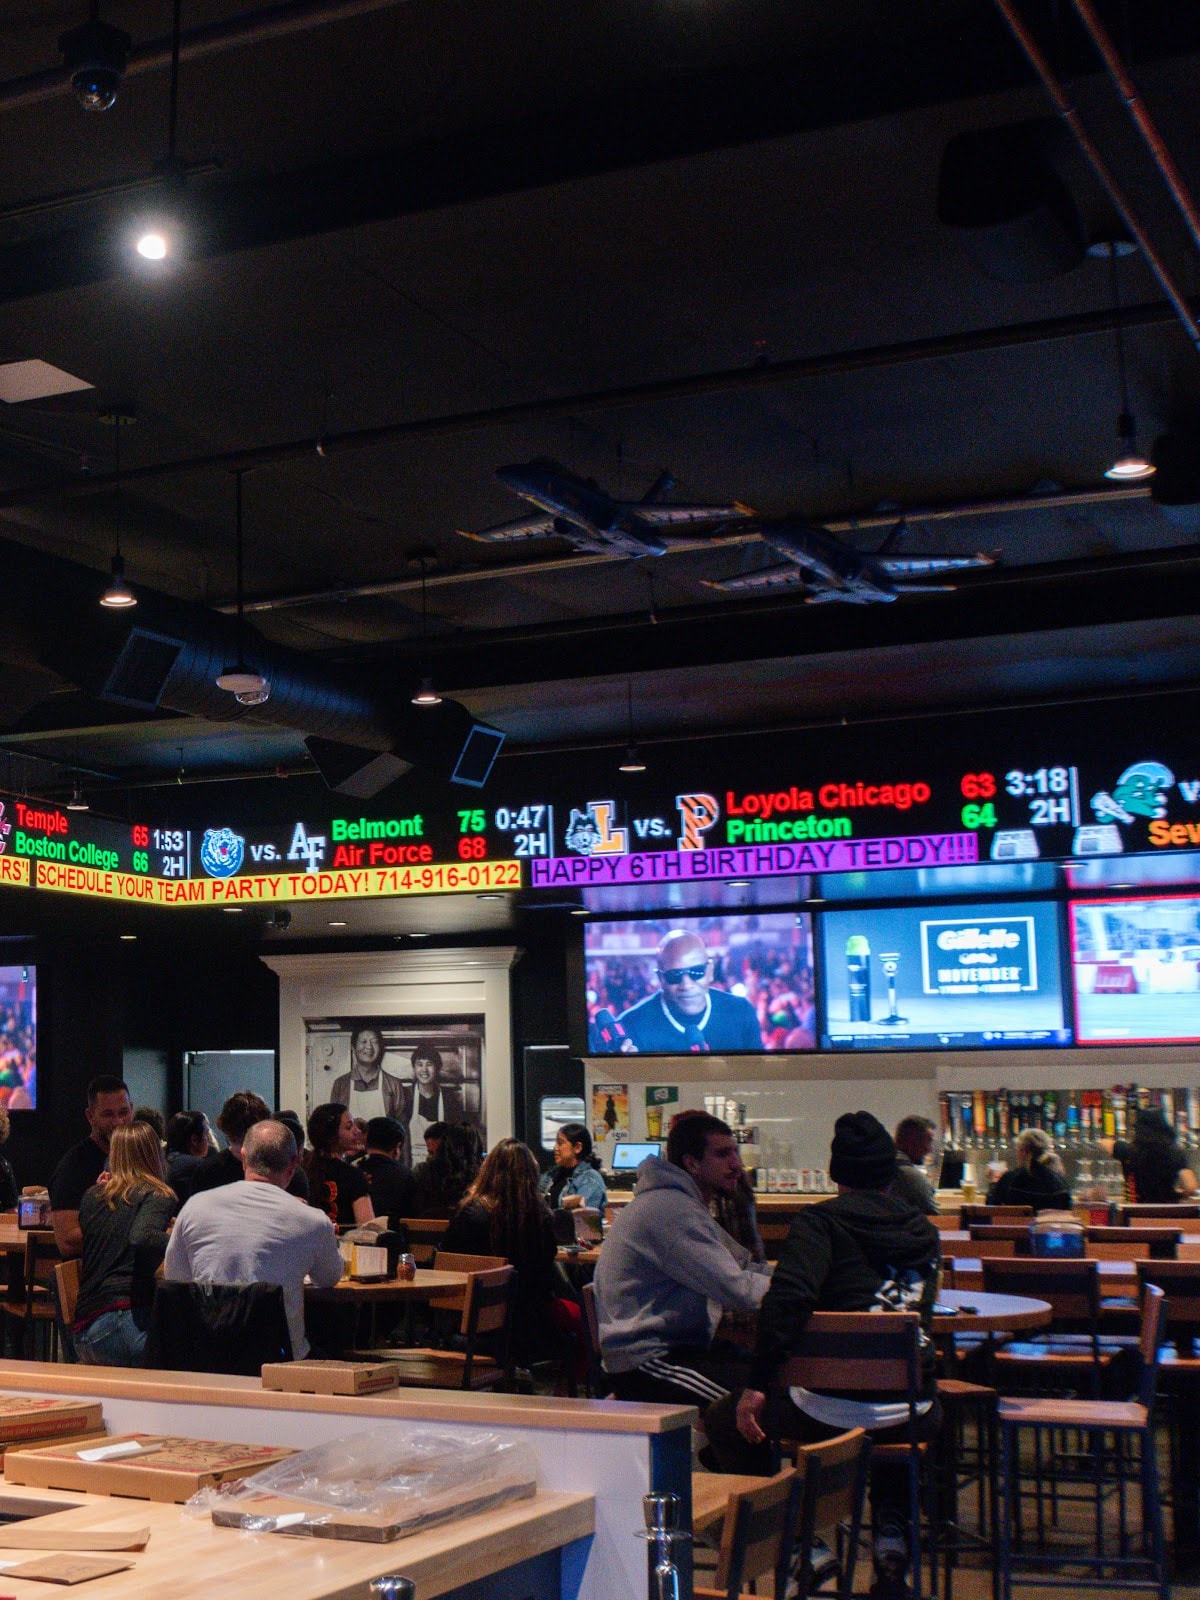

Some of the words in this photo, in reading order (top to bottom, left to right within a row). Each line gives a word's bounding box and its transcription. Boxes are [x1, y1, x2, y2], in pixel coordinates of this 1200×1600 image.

[961, 772, 996, 799] 63
[1005, 768, 1068, 797] 3:18
[726, 786, 814, 819] Loyola
[818, 781, 931, 811] Chicago
[1028, 798, 1071, 825] 2H
[16, 803, 69, 836] Temple
[332, 814, 423, 841] Belmont
[457, 809, 485, 833] 75
[495, 805, 543, 830] 0:47
[633, 818, 672, 839] vs.
[961, 802, 997, 829] 64
[132, 825, 149, 847] 65
[153, 828, 184, 852] 1:53
[726, 815, 852, 843] Princeton
[16, 832, 65, 860] Boston
[69, 841, 118, 870] College
[250, 843, 282, 862] vs.
[333, 844, 364, 867] Air
[370, 842, 433, 865] Force
[457, 837, 486, 859] 68
[514, 833, 546, 856] 2H
[132, 852, 149, 872] 66
[162, 856, 185, 877] 2H
[534, 857, 624, 884] HAPPY
[629, 854, 681, 878] 6TH
[691, 843, 832, 875] BIRTHDAY
[848, 834, 975, 866] TEDDY!!!
[37, 865, 113, 893] SCHEDULE
[116, 875, 153, 900] YOUR
[157, 881, 205, 902] TEAM
[212, 877, 286, 901] PARTY
[288, 872, 369, 896] TODAY!
[376, 863, 520, 891] 714-916-0122
